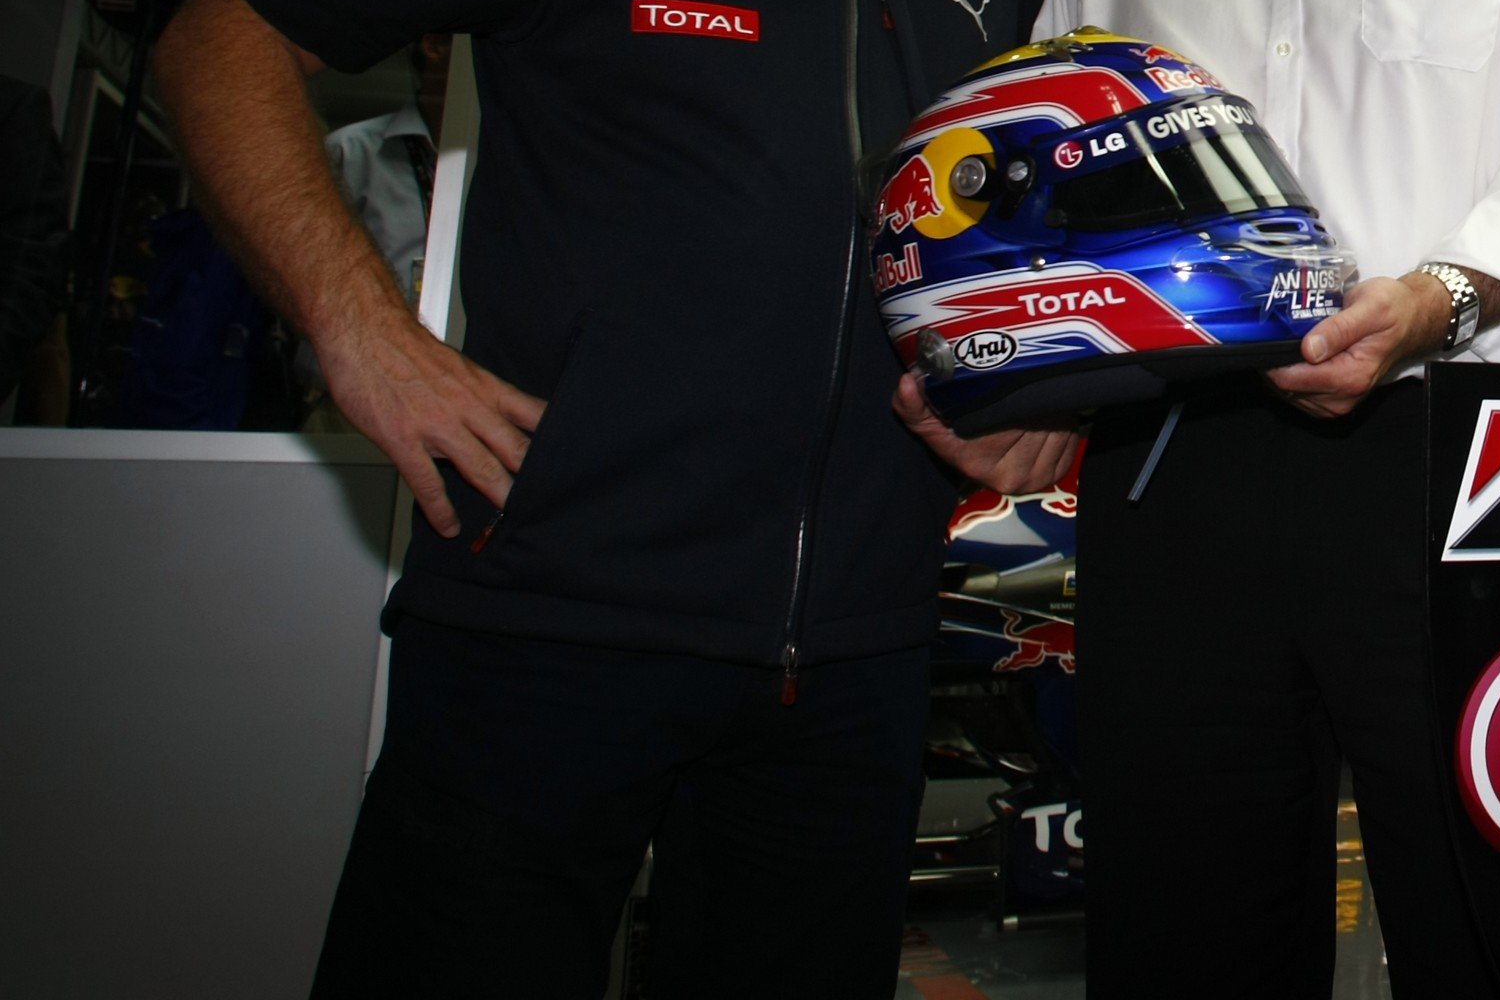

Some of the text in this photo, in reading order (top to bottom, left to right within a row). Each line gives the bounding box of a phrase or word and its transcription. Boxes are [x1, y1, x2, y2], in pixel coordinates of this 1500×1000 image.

[639, 4, 754, 35] TOTAL
[1147, 104, 1254, 139] GIVES YOU
[1089, 132, 1127, 157] LG
[884, 242, 922, 288] Bull
[1279, 267, 1335, 290] WINGS
[1018, 286, 1126, 317] TOTAL
[1291, 288, 1326, 310] LIFE
[962, 334, 1008, 361] Arai
